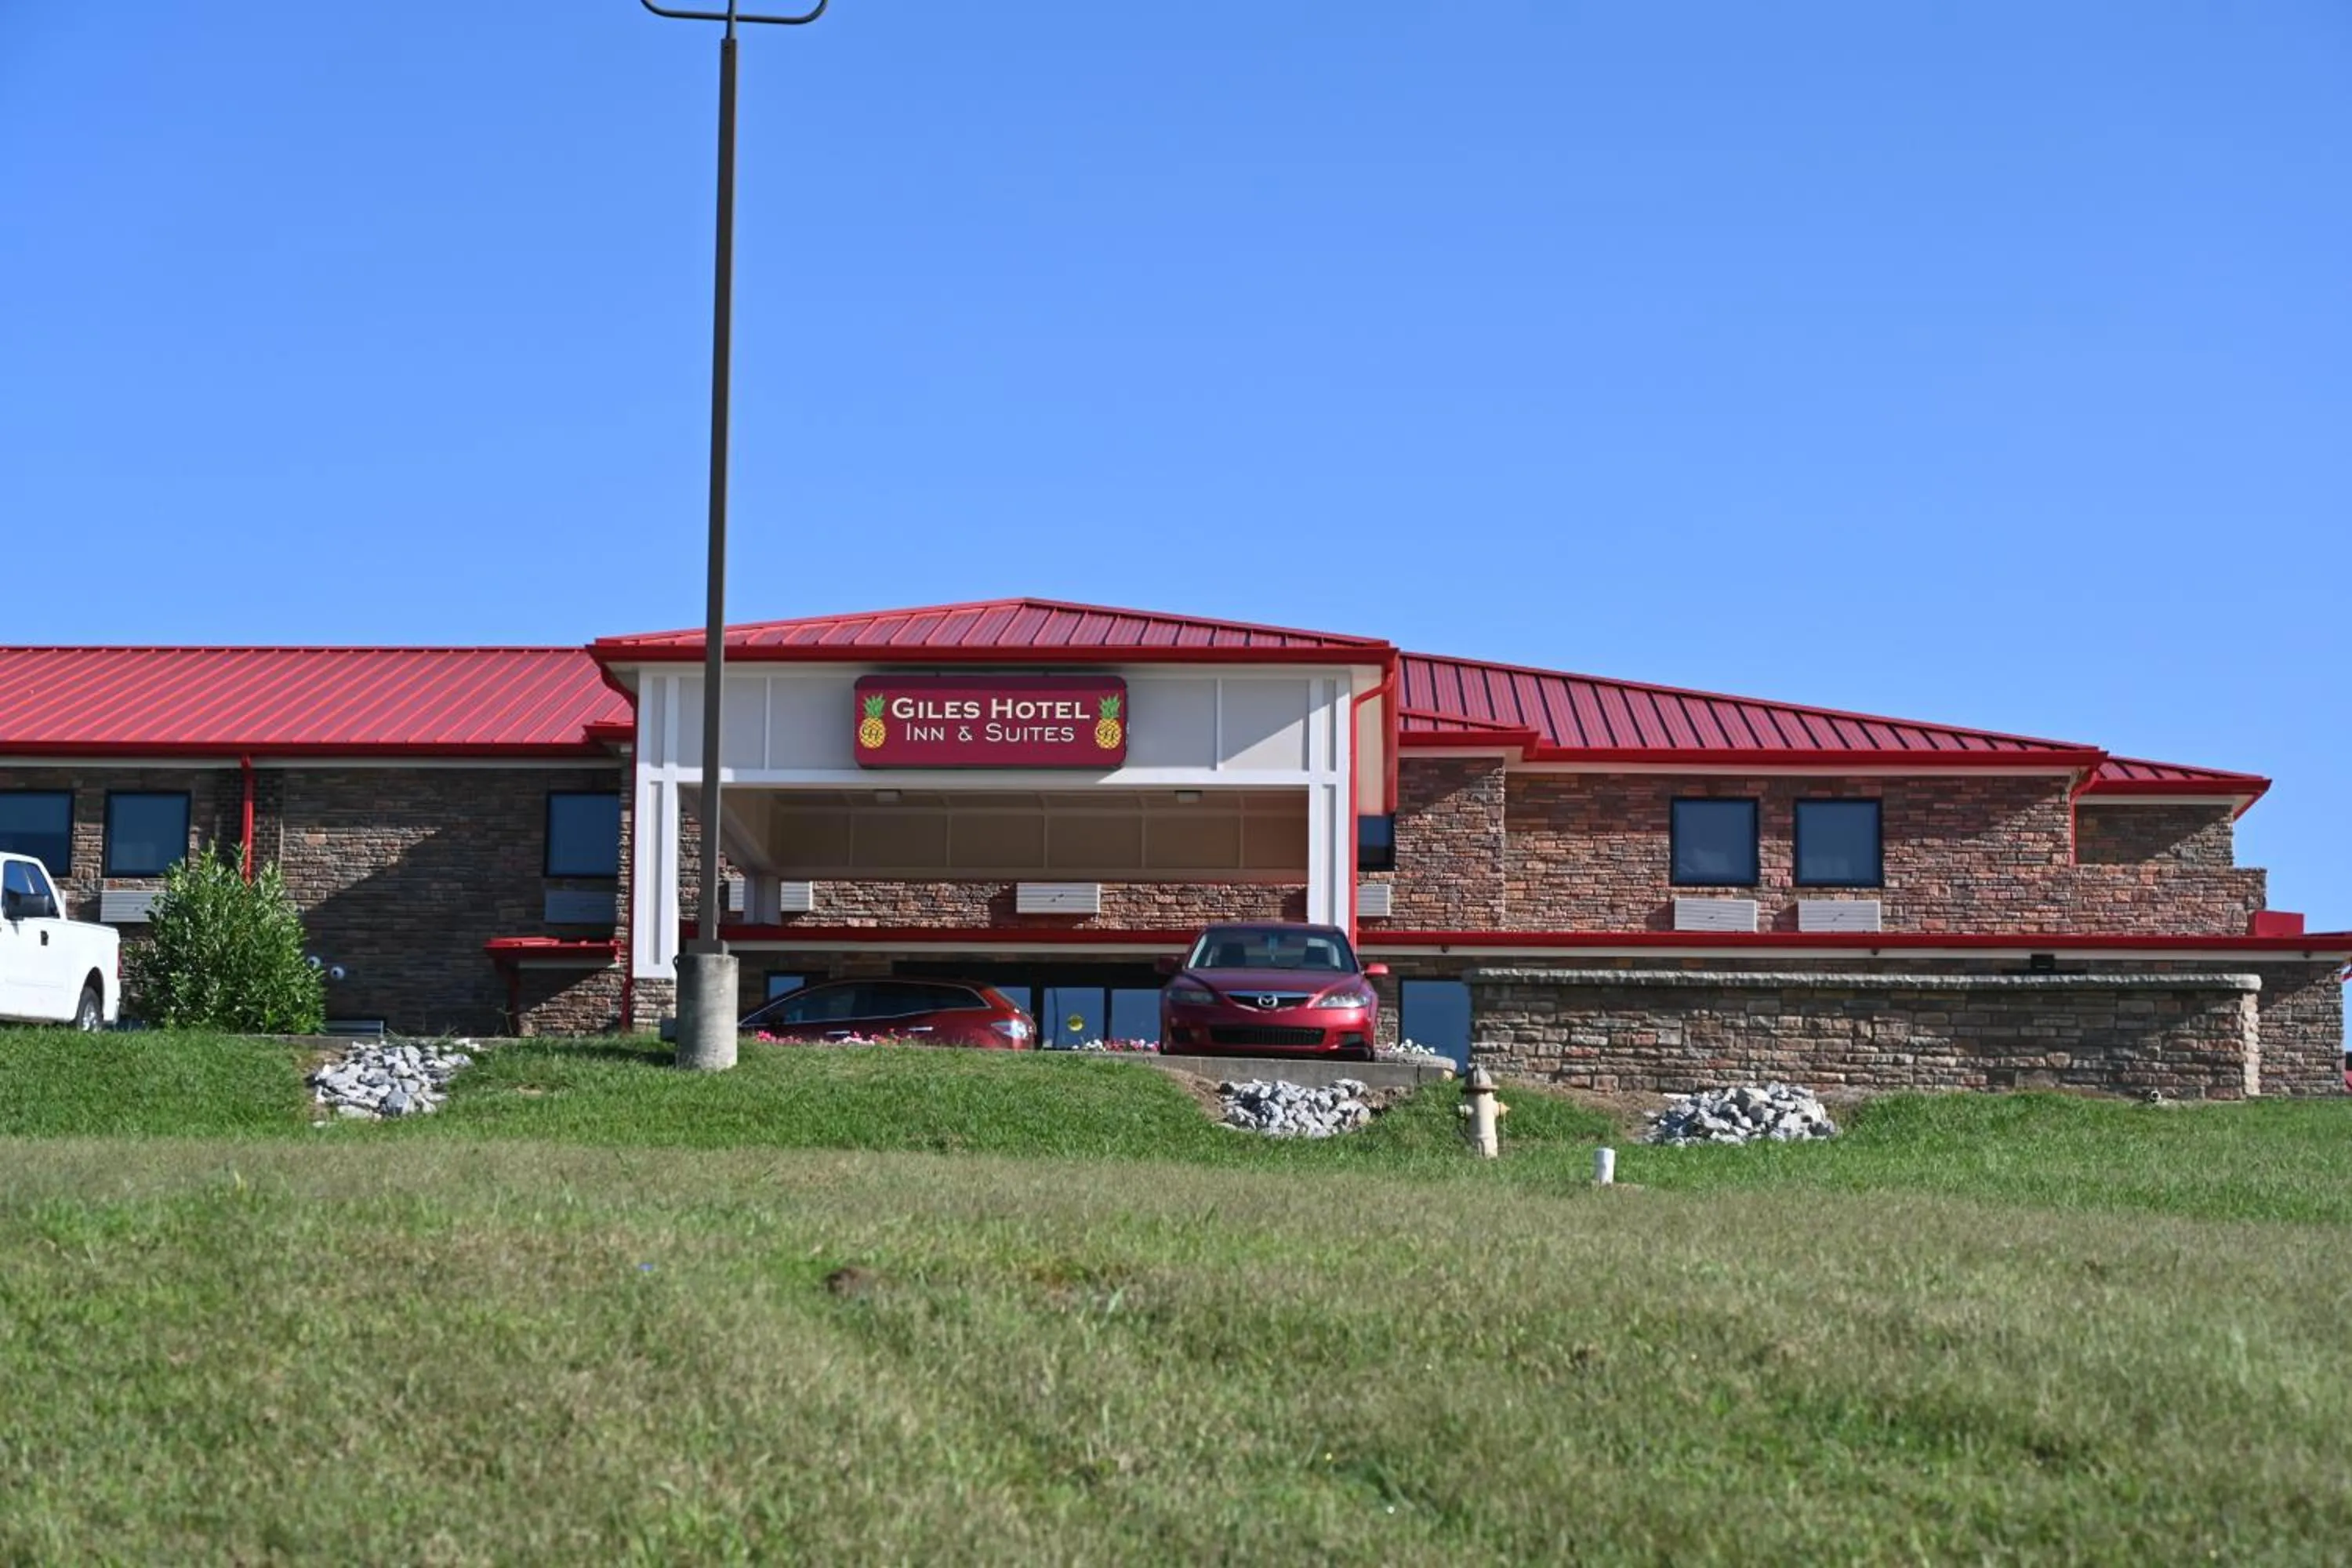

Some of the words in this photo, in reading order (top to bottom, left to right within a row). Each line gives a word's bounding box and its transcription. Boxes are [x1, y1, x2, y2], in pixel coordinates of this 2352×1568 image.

[891, 697, 980, 720] GILES
[990, 699, 1091, 720] HOTEL
[906, 723, 946, 741] INN
[957, 725, 974, 742] &
[985, 723, 1075, 742] SUITES
